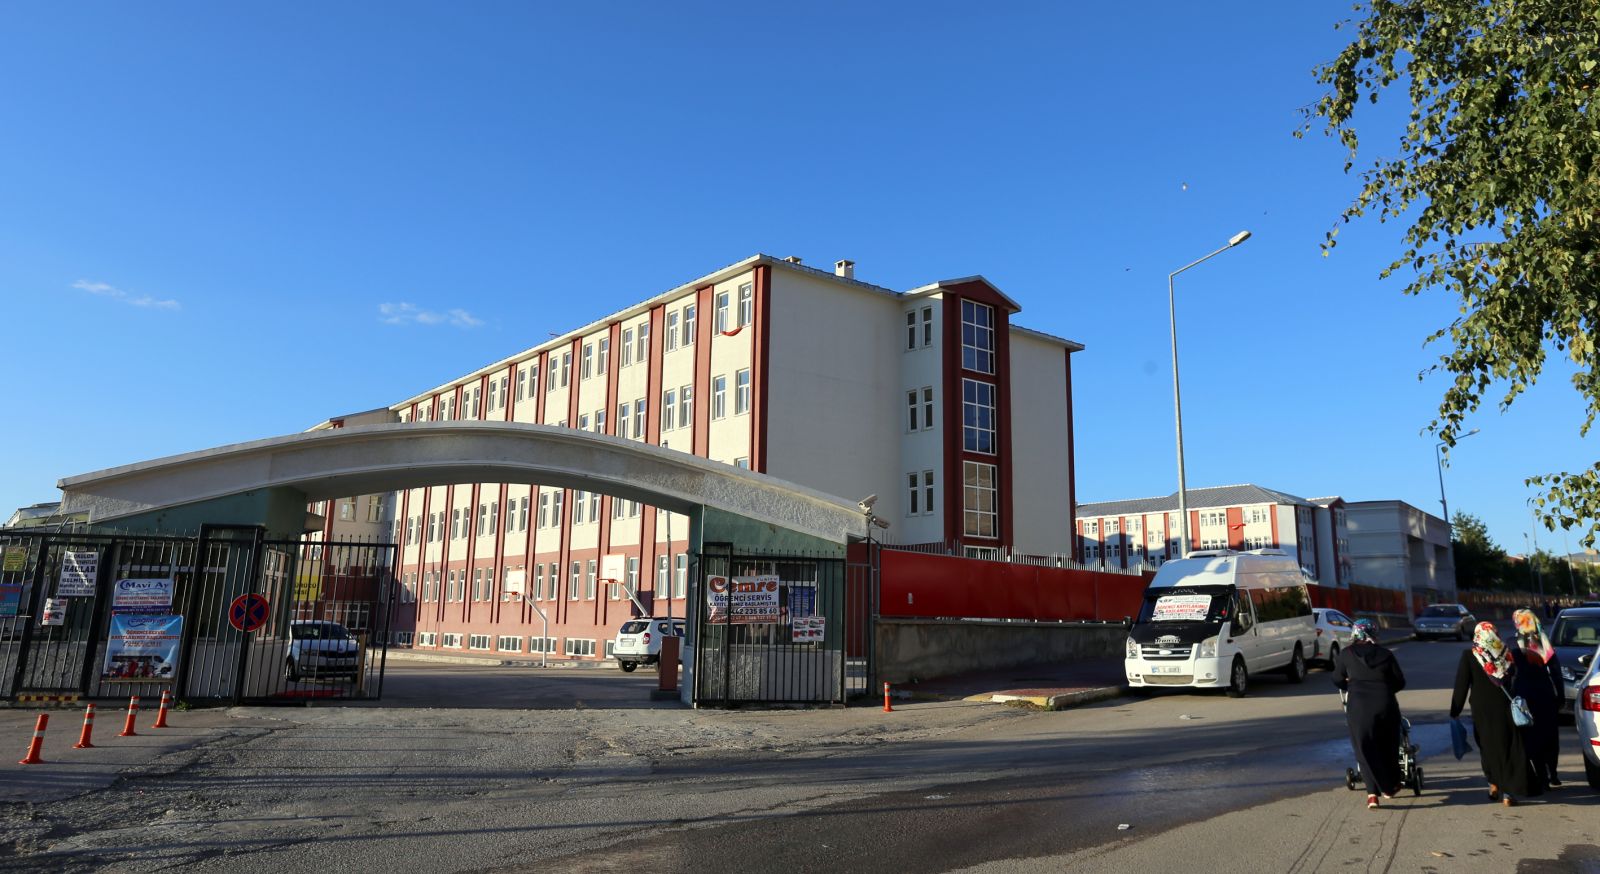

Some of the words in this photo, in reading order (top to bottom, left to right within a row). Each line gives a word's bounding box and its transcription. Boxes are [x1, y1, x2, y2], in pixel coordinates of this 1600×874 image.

[157, 582, 169, 590] Ay
[709, 577, 777, 593] Cemre
[747, 592, 772, 602] SERVİS
